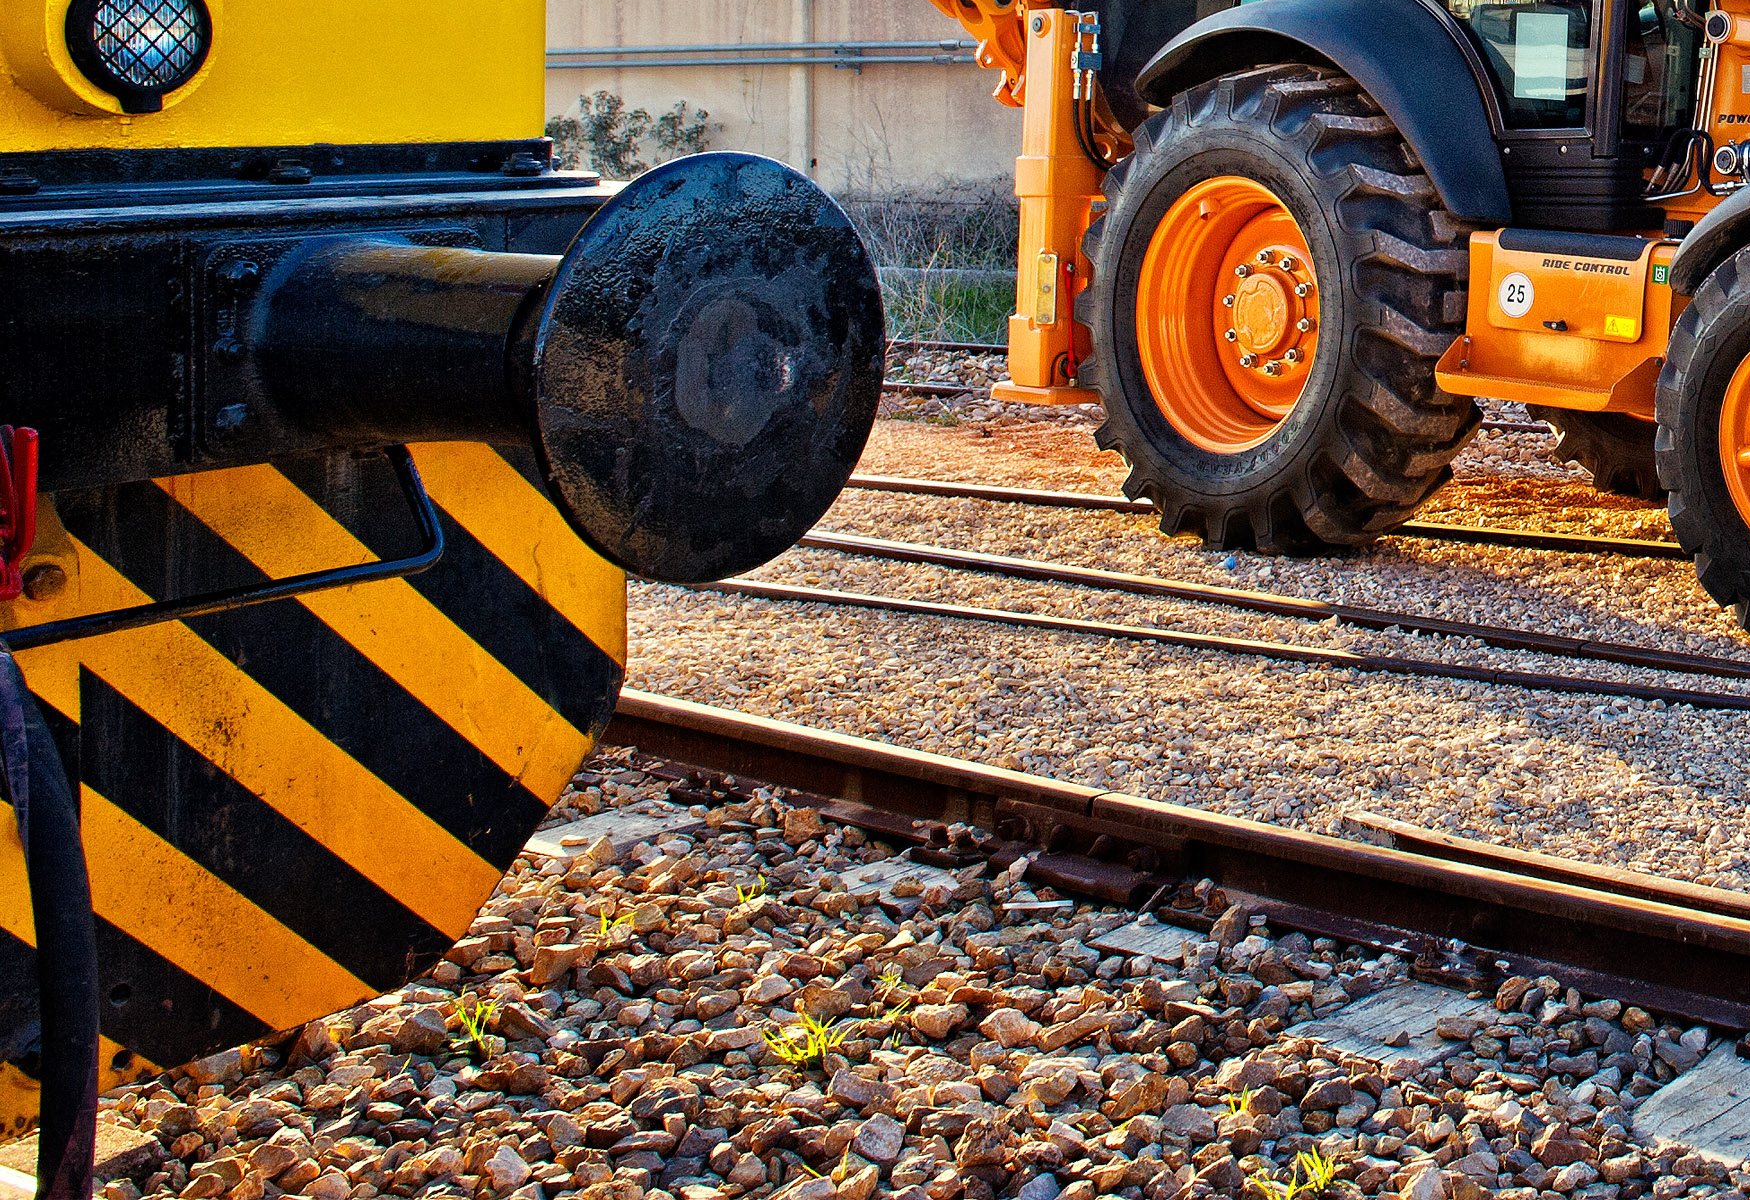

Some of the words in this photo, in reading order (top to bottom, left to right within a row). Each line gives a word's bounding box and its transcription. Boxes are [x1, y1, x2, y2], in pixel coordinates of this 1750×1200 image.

[1542, 258, 1572, 270] RIDE
[1574, 262, 1631, 276] CONTROL
[1507, 283, 1526, 304] 25
